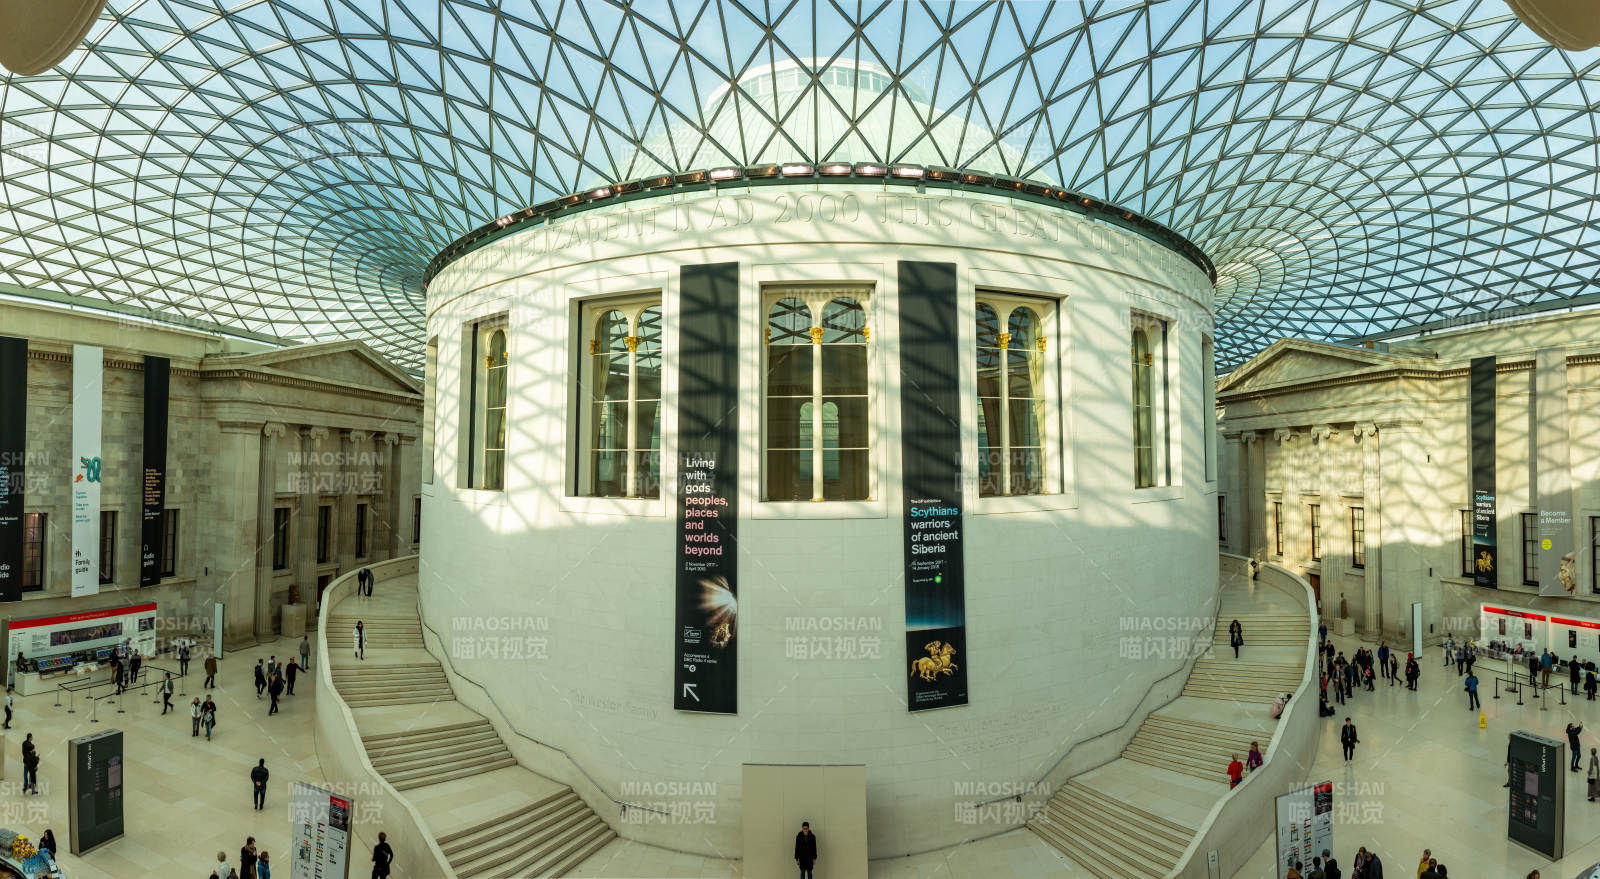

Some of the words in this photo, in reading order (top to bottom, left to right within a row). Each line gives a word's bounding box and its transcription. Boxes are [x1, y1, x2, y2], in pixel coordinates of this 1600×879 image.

[774, 193, 860, 224] 2000
[877, 195, 953, 227] THIS
[969, 202, 1066, 242] GREAT
[686, 458, 715, 470] Living
[686, 470, 706, 480] with
[686, 483, 711, 494] gods
[686, 496, 728, 507] peoples,
[685, 508, 718, 518] places
[911, 507, 958, 518] Scythians
[685, 520, 704, 530] and
[911, 519, 950, 529] warriors
[685, 533, 719, 542] worlds
[911, 532, 921, 542] of
[923, 530, 958, 541] ancient
[685, 545, 723, 556] beyond
[912, 543, 946, 554] Siberia
